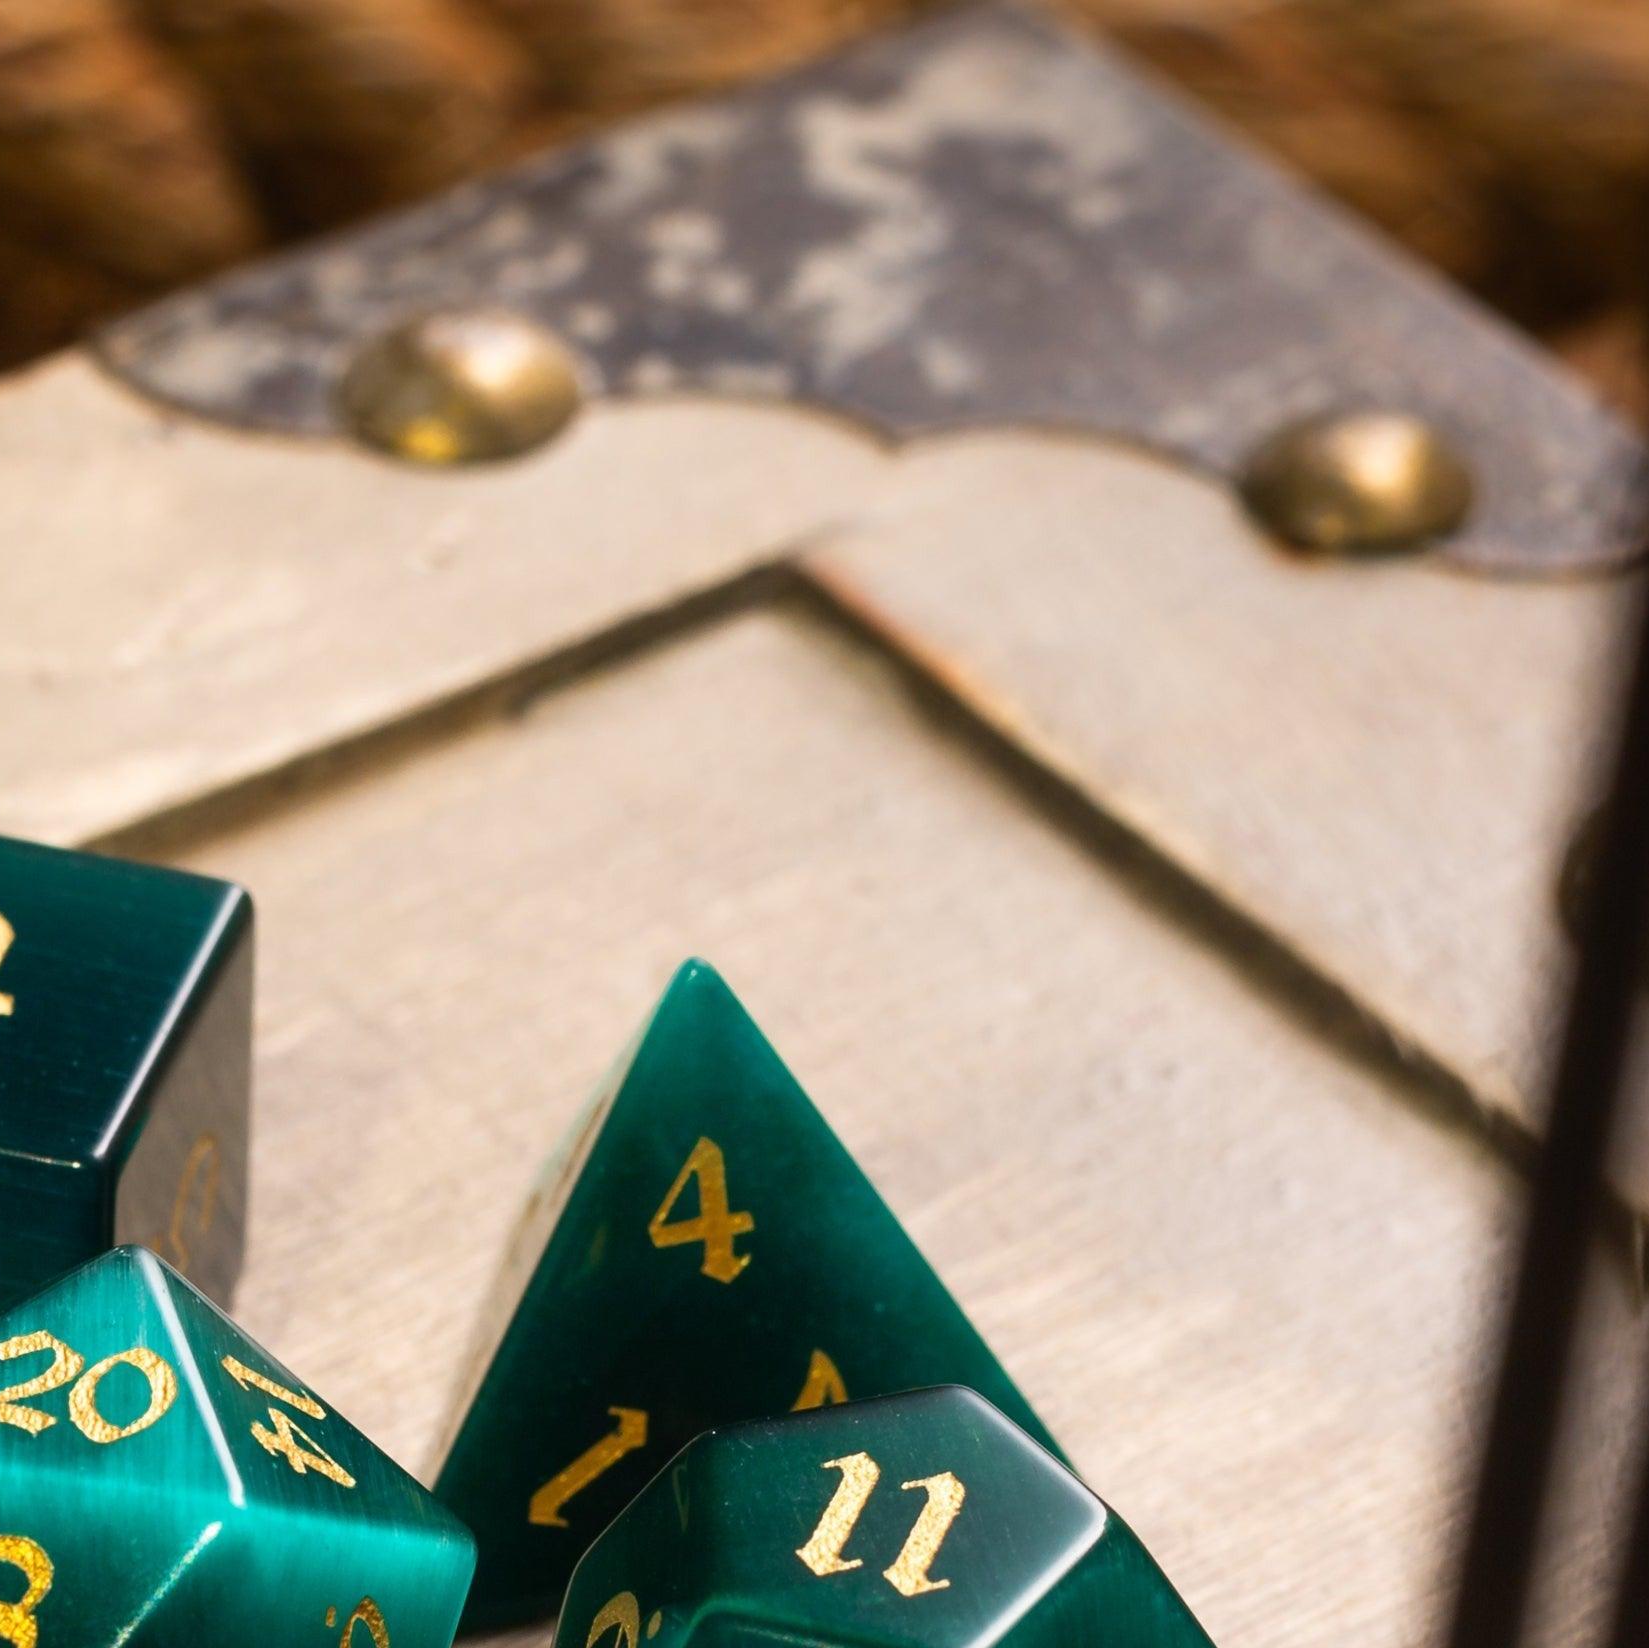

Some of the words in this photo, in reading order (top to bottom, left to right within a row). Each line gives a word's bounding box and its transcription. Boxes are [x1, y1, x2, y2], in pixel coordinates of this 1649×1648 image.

[647, 1136, 754, 1284] 4
[220, 1355, 356, 1488] 14
[528, 1406, 650, 1528] 1
[795, 1451, 966, 1598] 11
